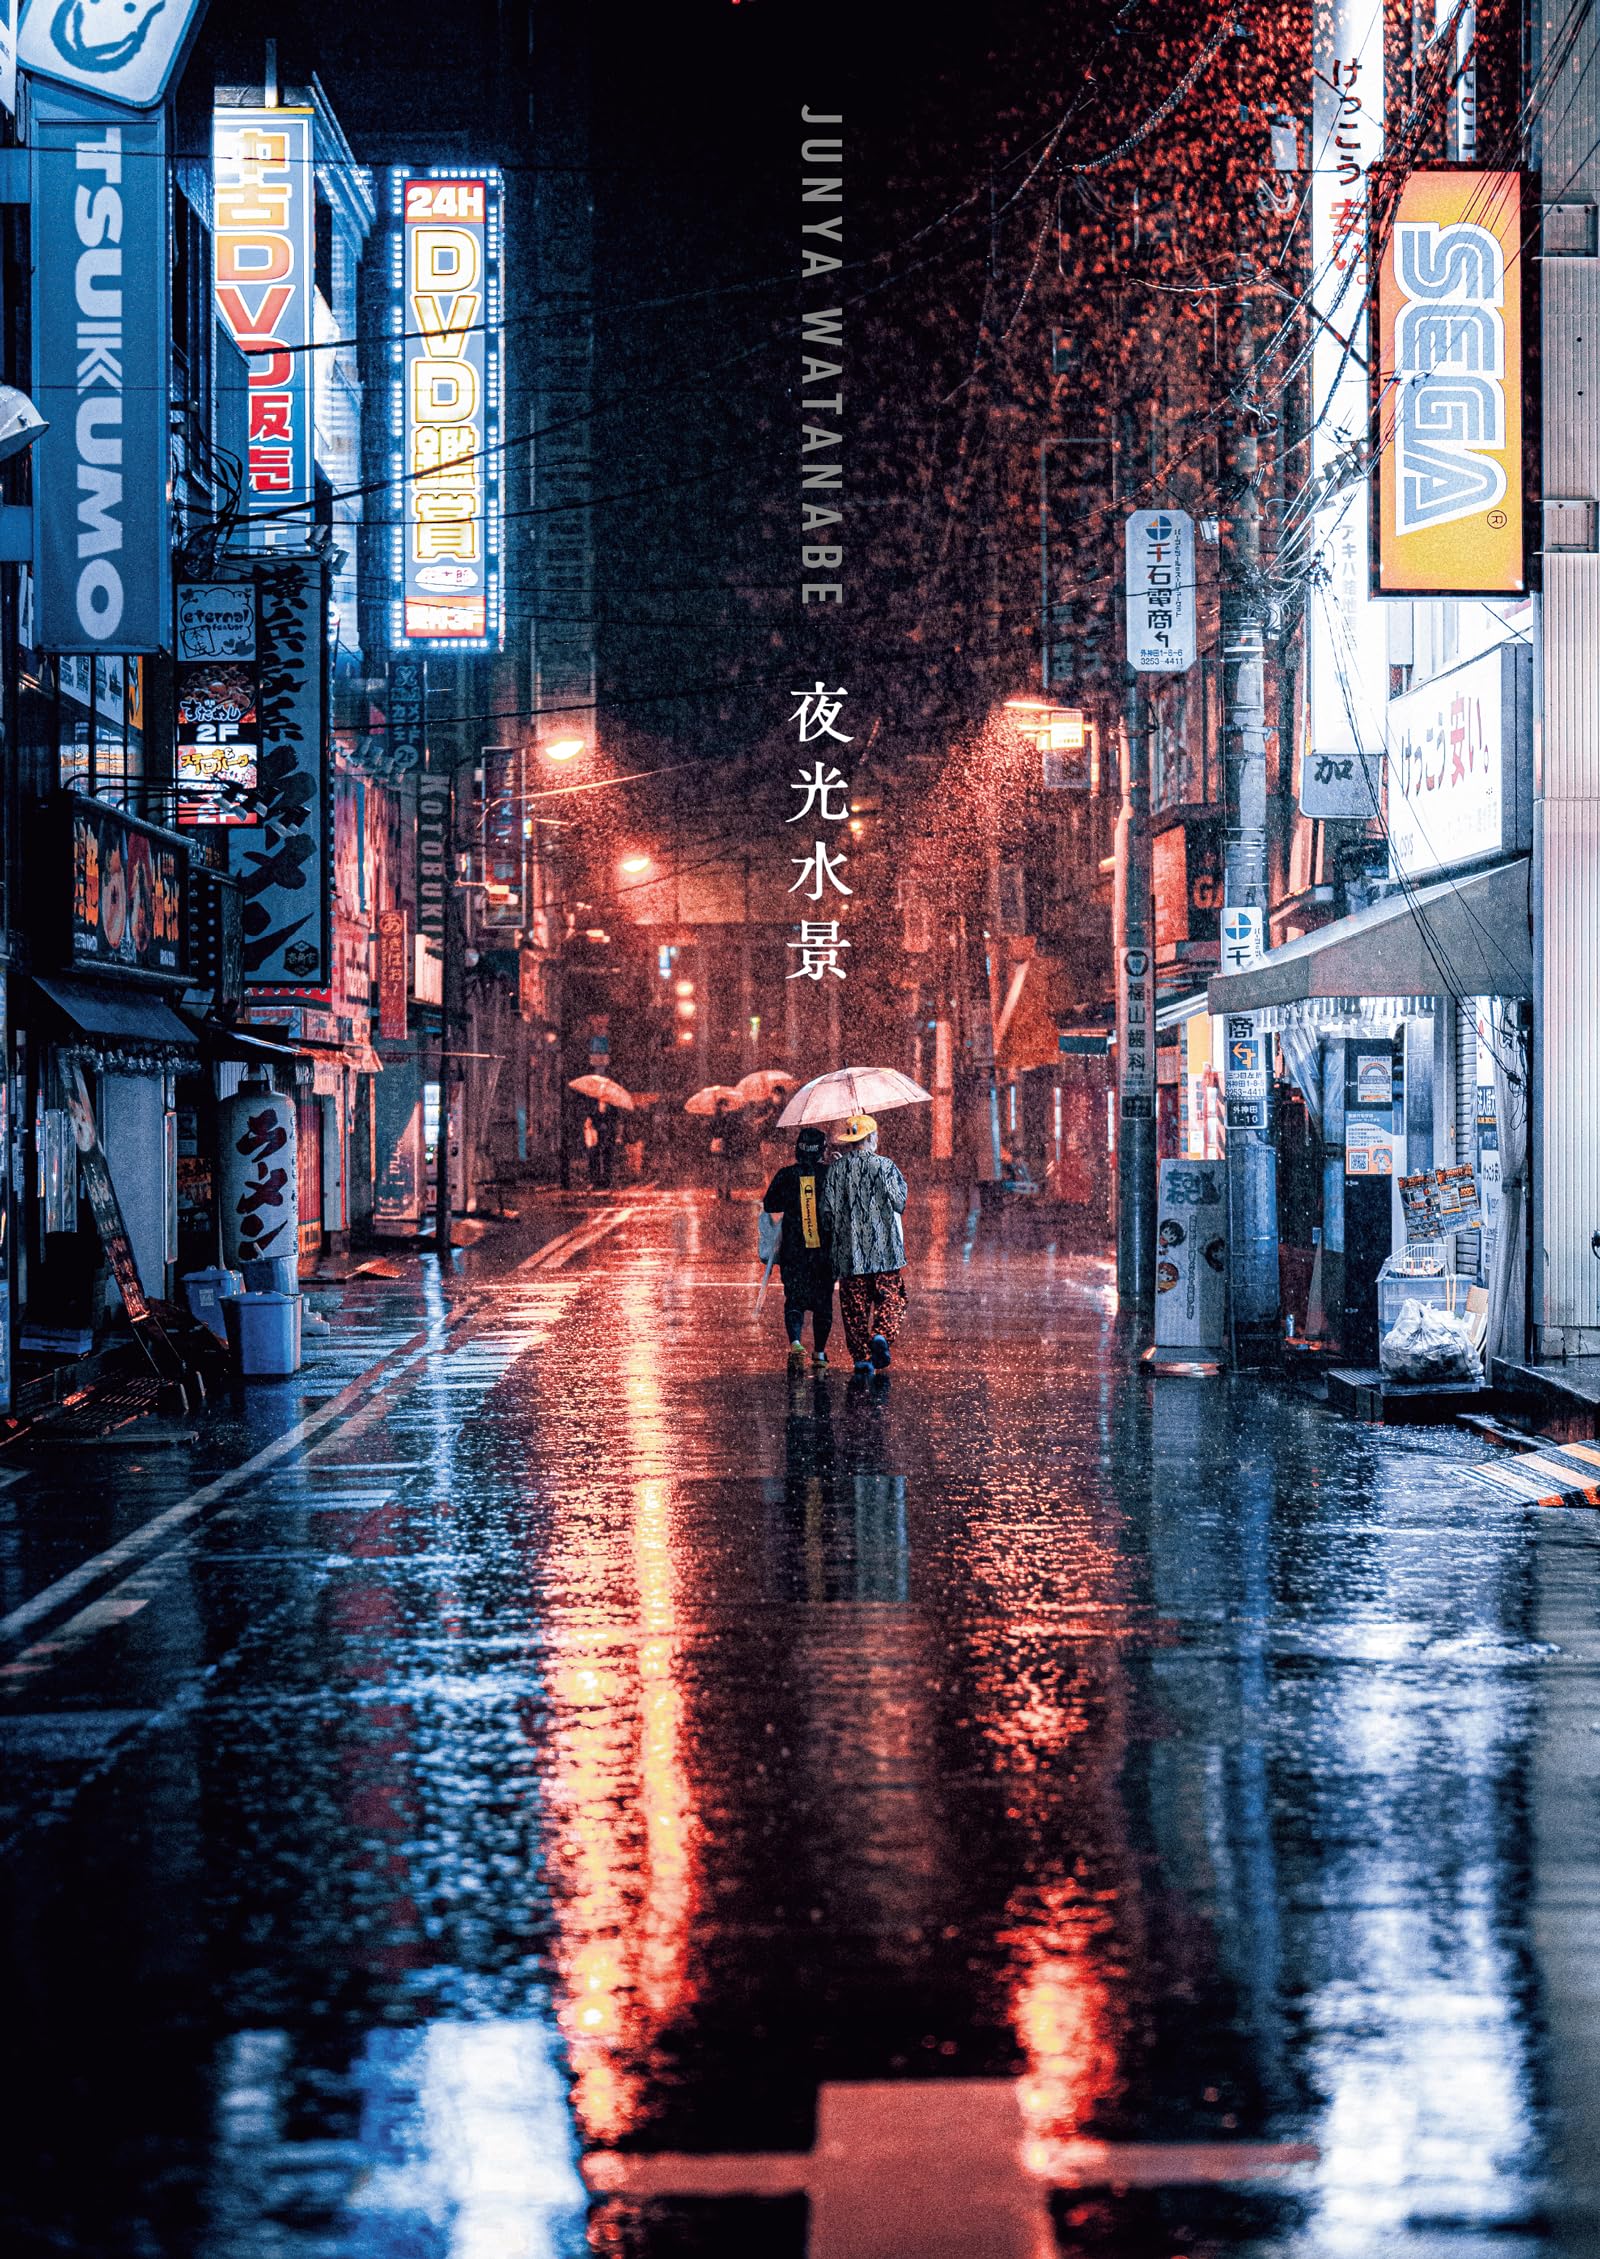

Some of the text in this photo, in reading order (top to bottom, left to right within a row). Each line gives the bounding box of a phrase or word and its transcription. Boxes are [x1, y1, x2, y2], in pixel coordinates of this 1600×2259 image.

[406, 186, 484, 217] 24H
[74, 127, 124, 641] TSUKUMO
[414, 229, 478, 559] DVD鑑賞
[1394, 222, 1508, 537] SEGA
[1147, 542, 1172, 629] 千石電商
[184, 609, 249, 623] eternal
[1140, 658, 1183, 666] 3253-4411
[196, 723, 239, 742] 2F
[1401, 691, 1490, 800] けっこう安い。
[1226, 945, 1252, 967] 千
[1127, 981, 1147, 1072] 福山歯科
[1225, 1088, 1265, 1097] 3253-4411
[1232, 1105, 1259, 1115] 外神田
[1233, 1115, 1259, 1124] 1-10
[235, 1107, 288, 1261] ラーメン
